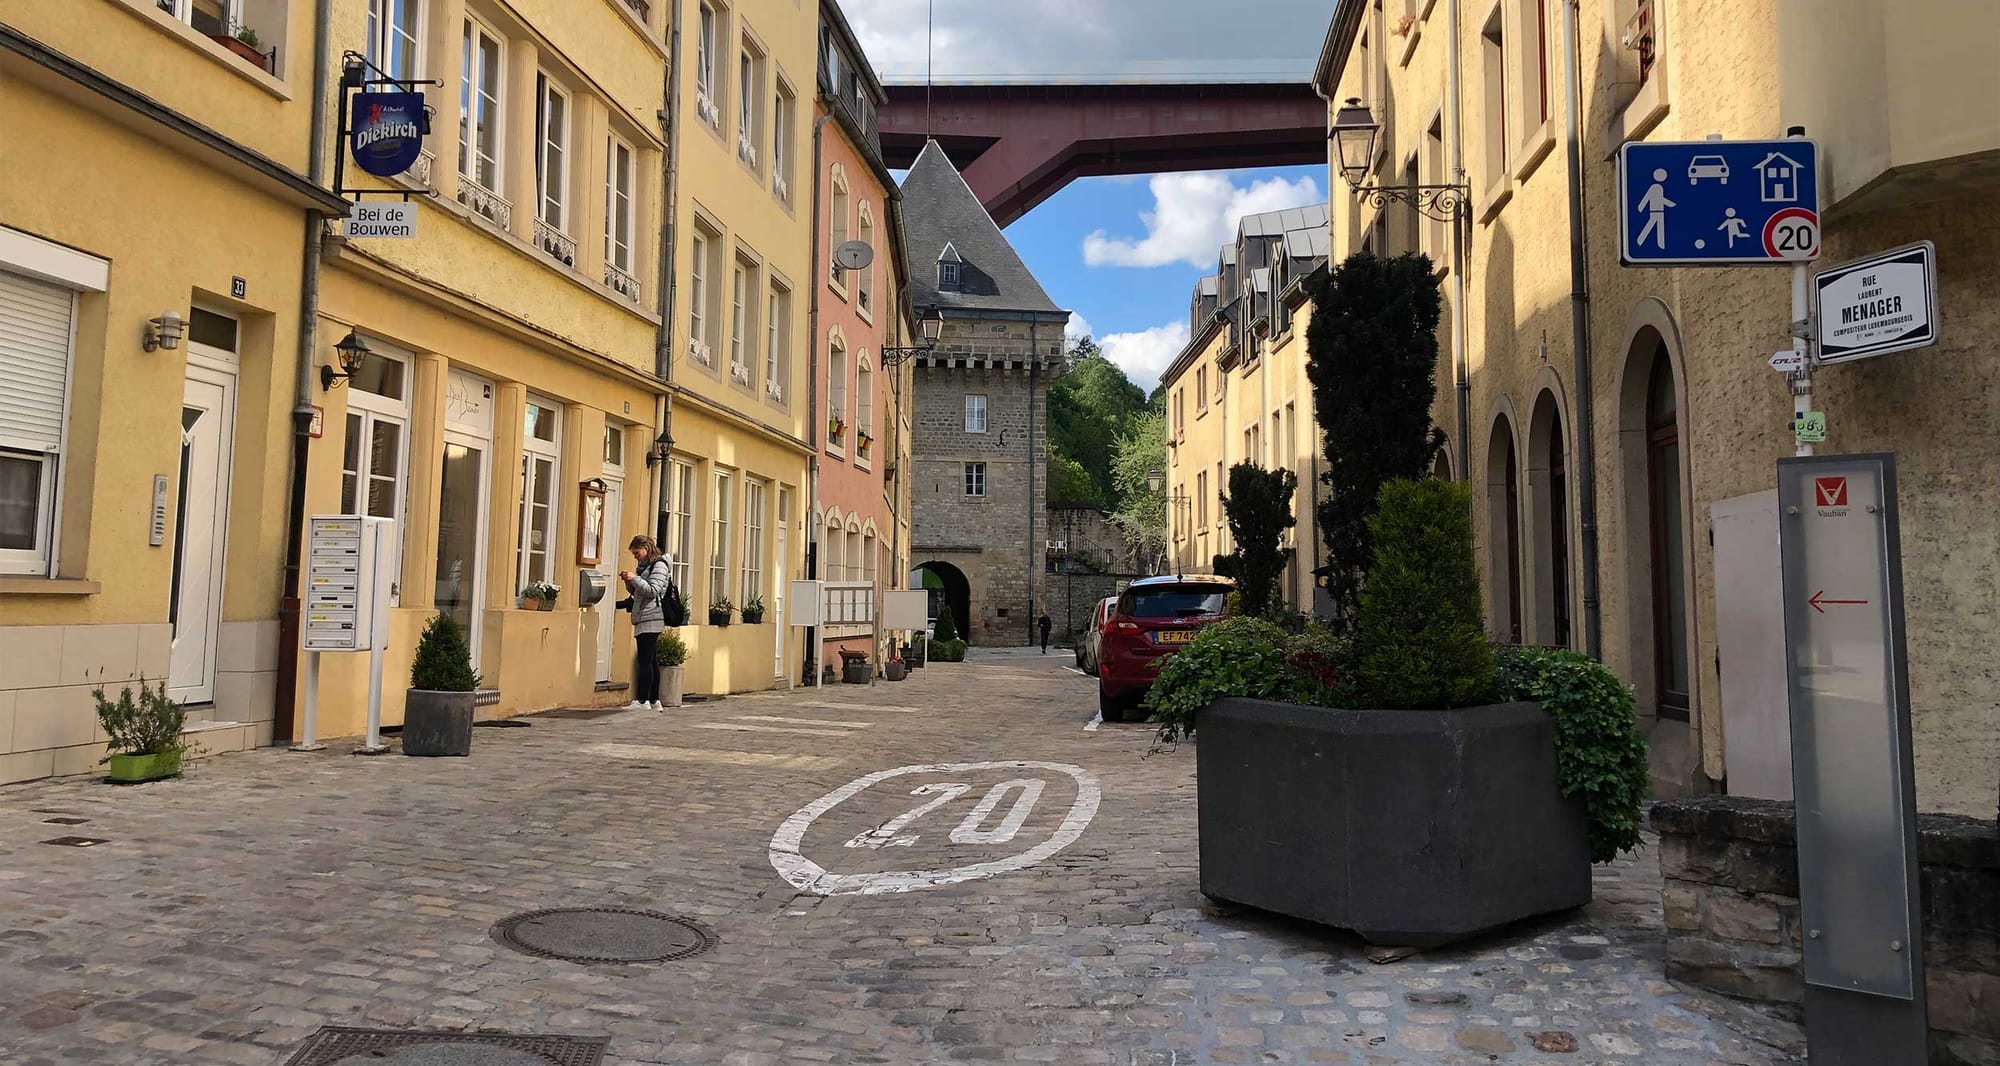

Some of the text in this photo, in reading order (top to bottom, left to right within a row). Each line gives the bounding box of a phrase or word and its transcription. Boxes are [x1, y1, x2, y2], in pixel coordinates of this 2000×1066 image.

[357, 121, 417, 150] Diekirch
[358, 208, 404, 221] Bei de
[350, 222, 409, 236] Bouwen
[1778, 225, 1812, 250] 20
[1862, 275, 1876, 287] RUE
[1857, 288, 1882, 300] LAURENT
[1842, 296, 1902, 324] MENAGER
[1833, 324, 1867, 337] COMPOSITEUR
[1163, 632, 1195, 641] EF 742
[844, 778, 1046, 850] 20
